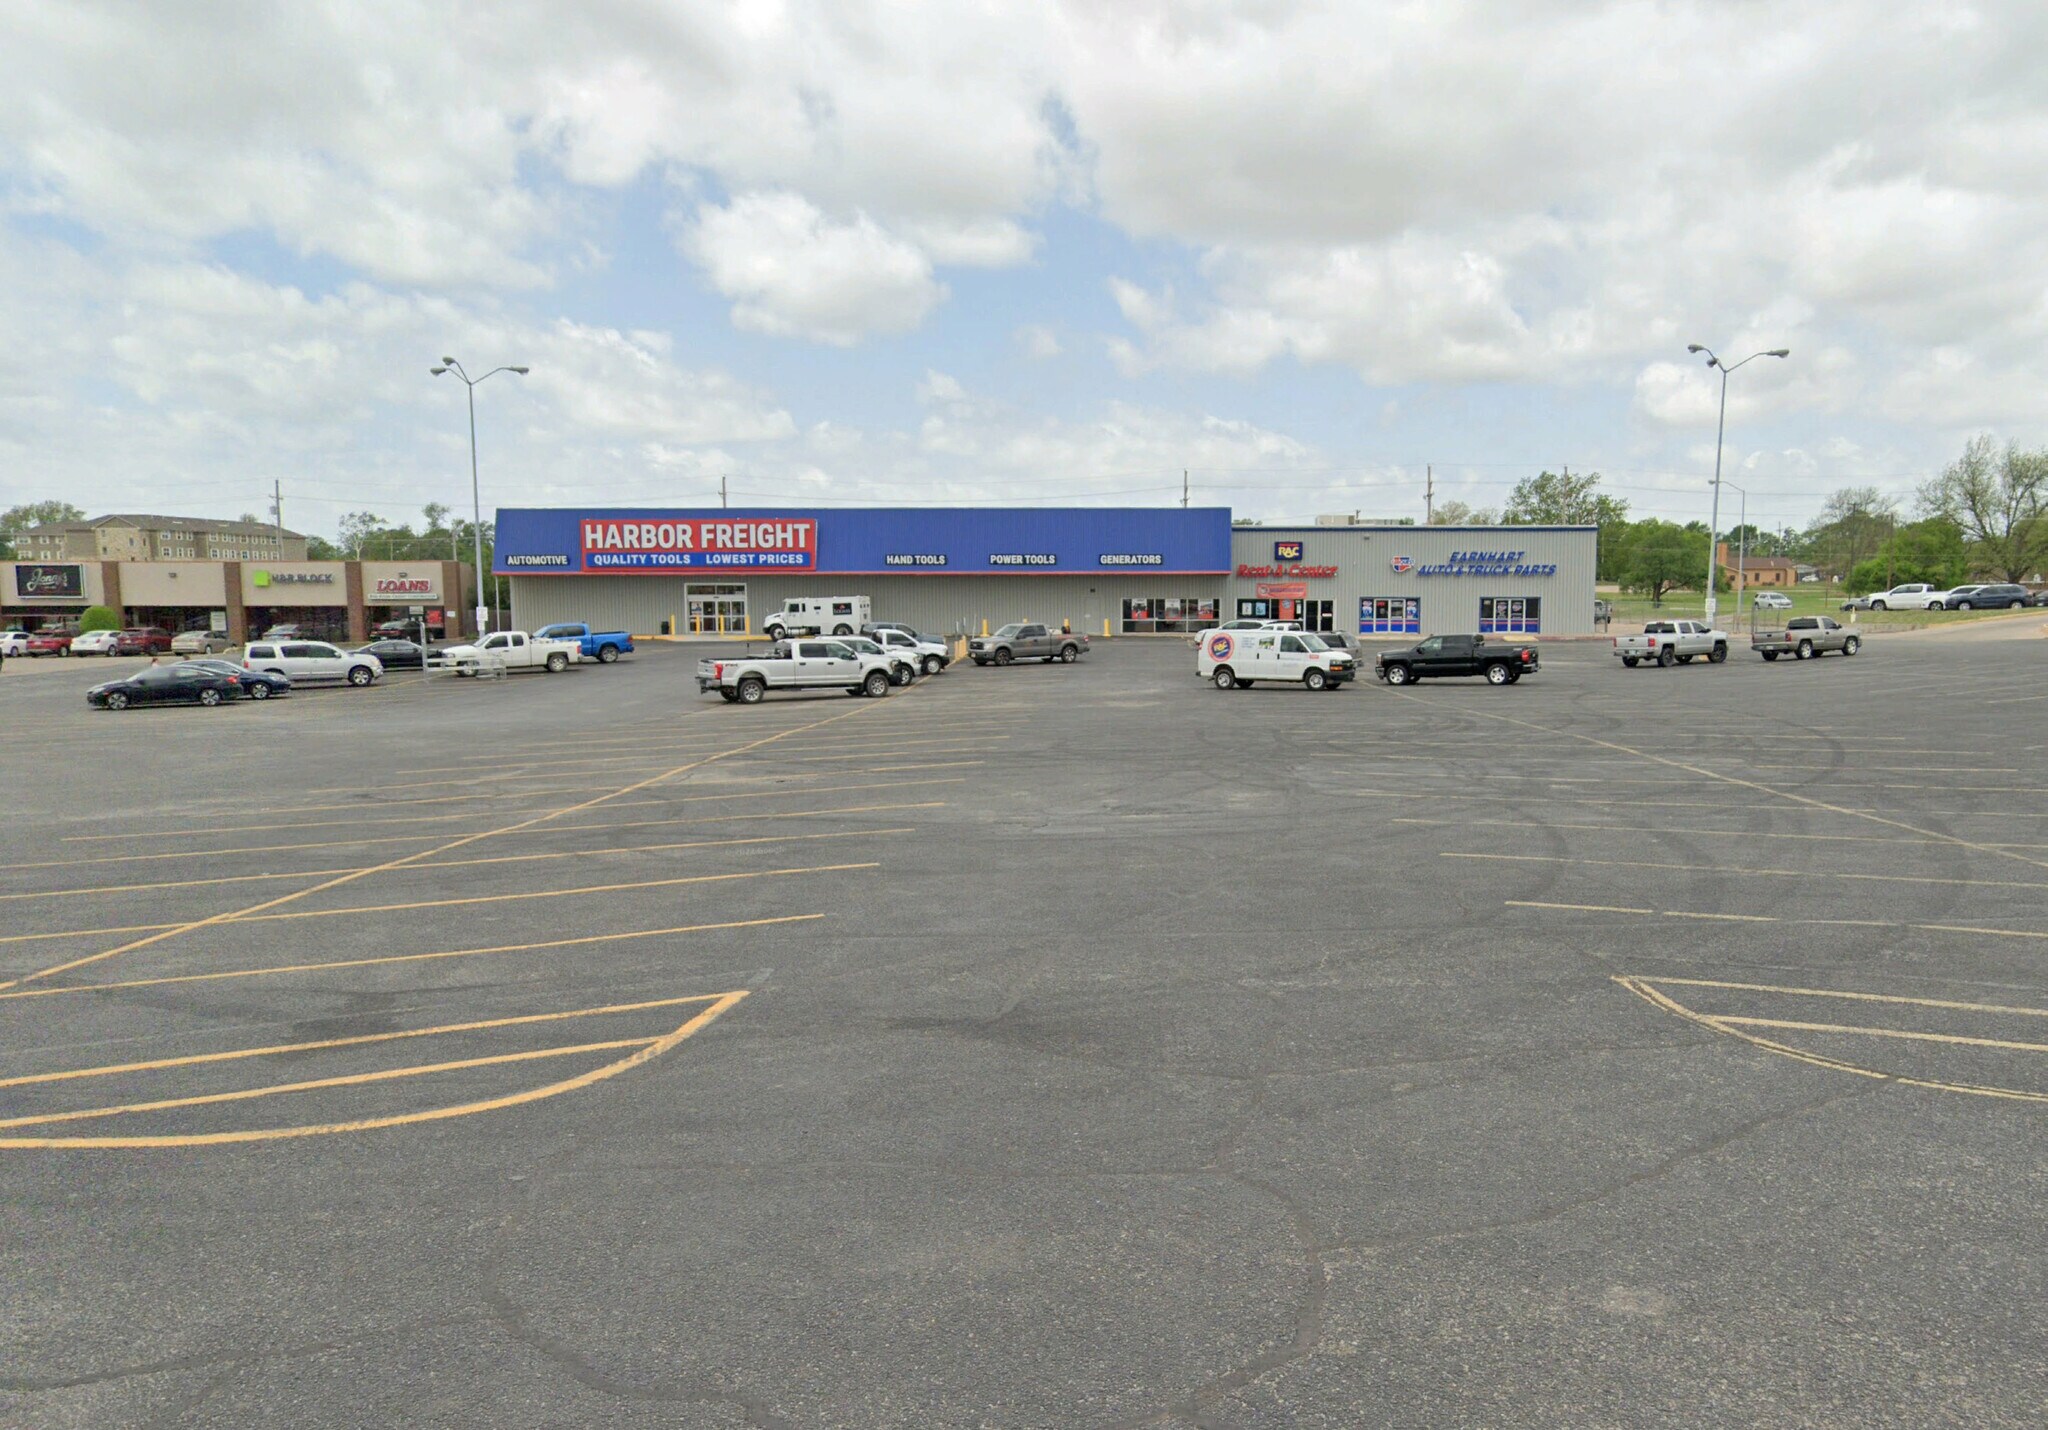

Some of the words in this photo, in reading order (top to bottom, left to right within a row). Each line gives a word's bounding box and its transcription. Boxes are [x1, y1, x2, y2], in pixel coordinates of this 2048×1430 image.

[584, 523, 694, 549] HARBOR
[700, 523, 811, 549] FREIGHT
[1278, 546, 1300, 558] RAC
[1449, 551, 1525, 563] EARNHART
[507, 555, 568, 565] AUTOMOTIVE
[593, 554, 647, 566] QUALITY
[650, 554, 691, 565] TOOLS
[705, 554, 756, 565] LOWEST
[758, 554, 804, 565] PRICES
[886, 555, 913, 565] HAND
[914, 555, 946, 565] TOOLS
[990, 554, 1023, 564] POWER
[1024, 554, 1056, 564] TOOLS
[1100, 555, 1162, 564] GENERATORS
[1416, 564, 1453, 577] AUTO
[1455, 564, 1465, 577] &
[1467, 564, 1512, 577] TRUCK
[1513, 564, 1557, 577] PARTS
[271, 573, 297, 585] H&R
[297, 573, 335, 585] BLOCK
[376, 579, 430, 593] LOANS
